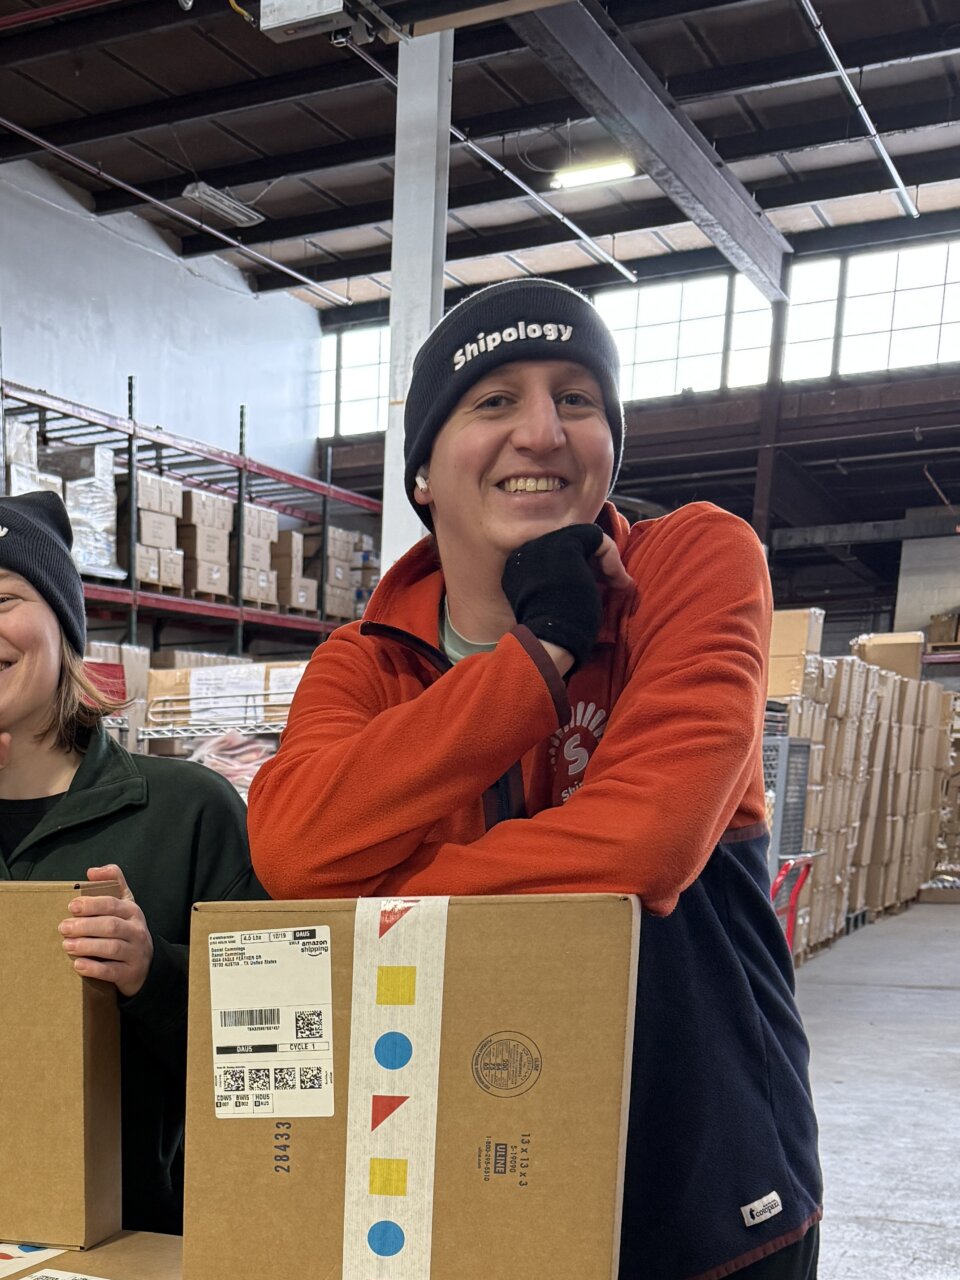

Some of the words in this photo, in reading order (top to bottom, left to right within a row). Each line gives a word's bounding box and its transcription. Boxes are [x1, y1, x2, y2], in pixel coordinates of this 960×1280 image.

[453, 321, 573, 371] Shipology
[561, 781, 583, 802] Shi
[300, 945, 329, 953] shipping
[289, 1042, 308, 1051] CYCLE
[520, 1133, 531, 1145] 13
[274, 1121, 292, 1174] 28433
[495, 1144, 506, 1173] ULINE
[520, 1157, 530, 1169] 13
